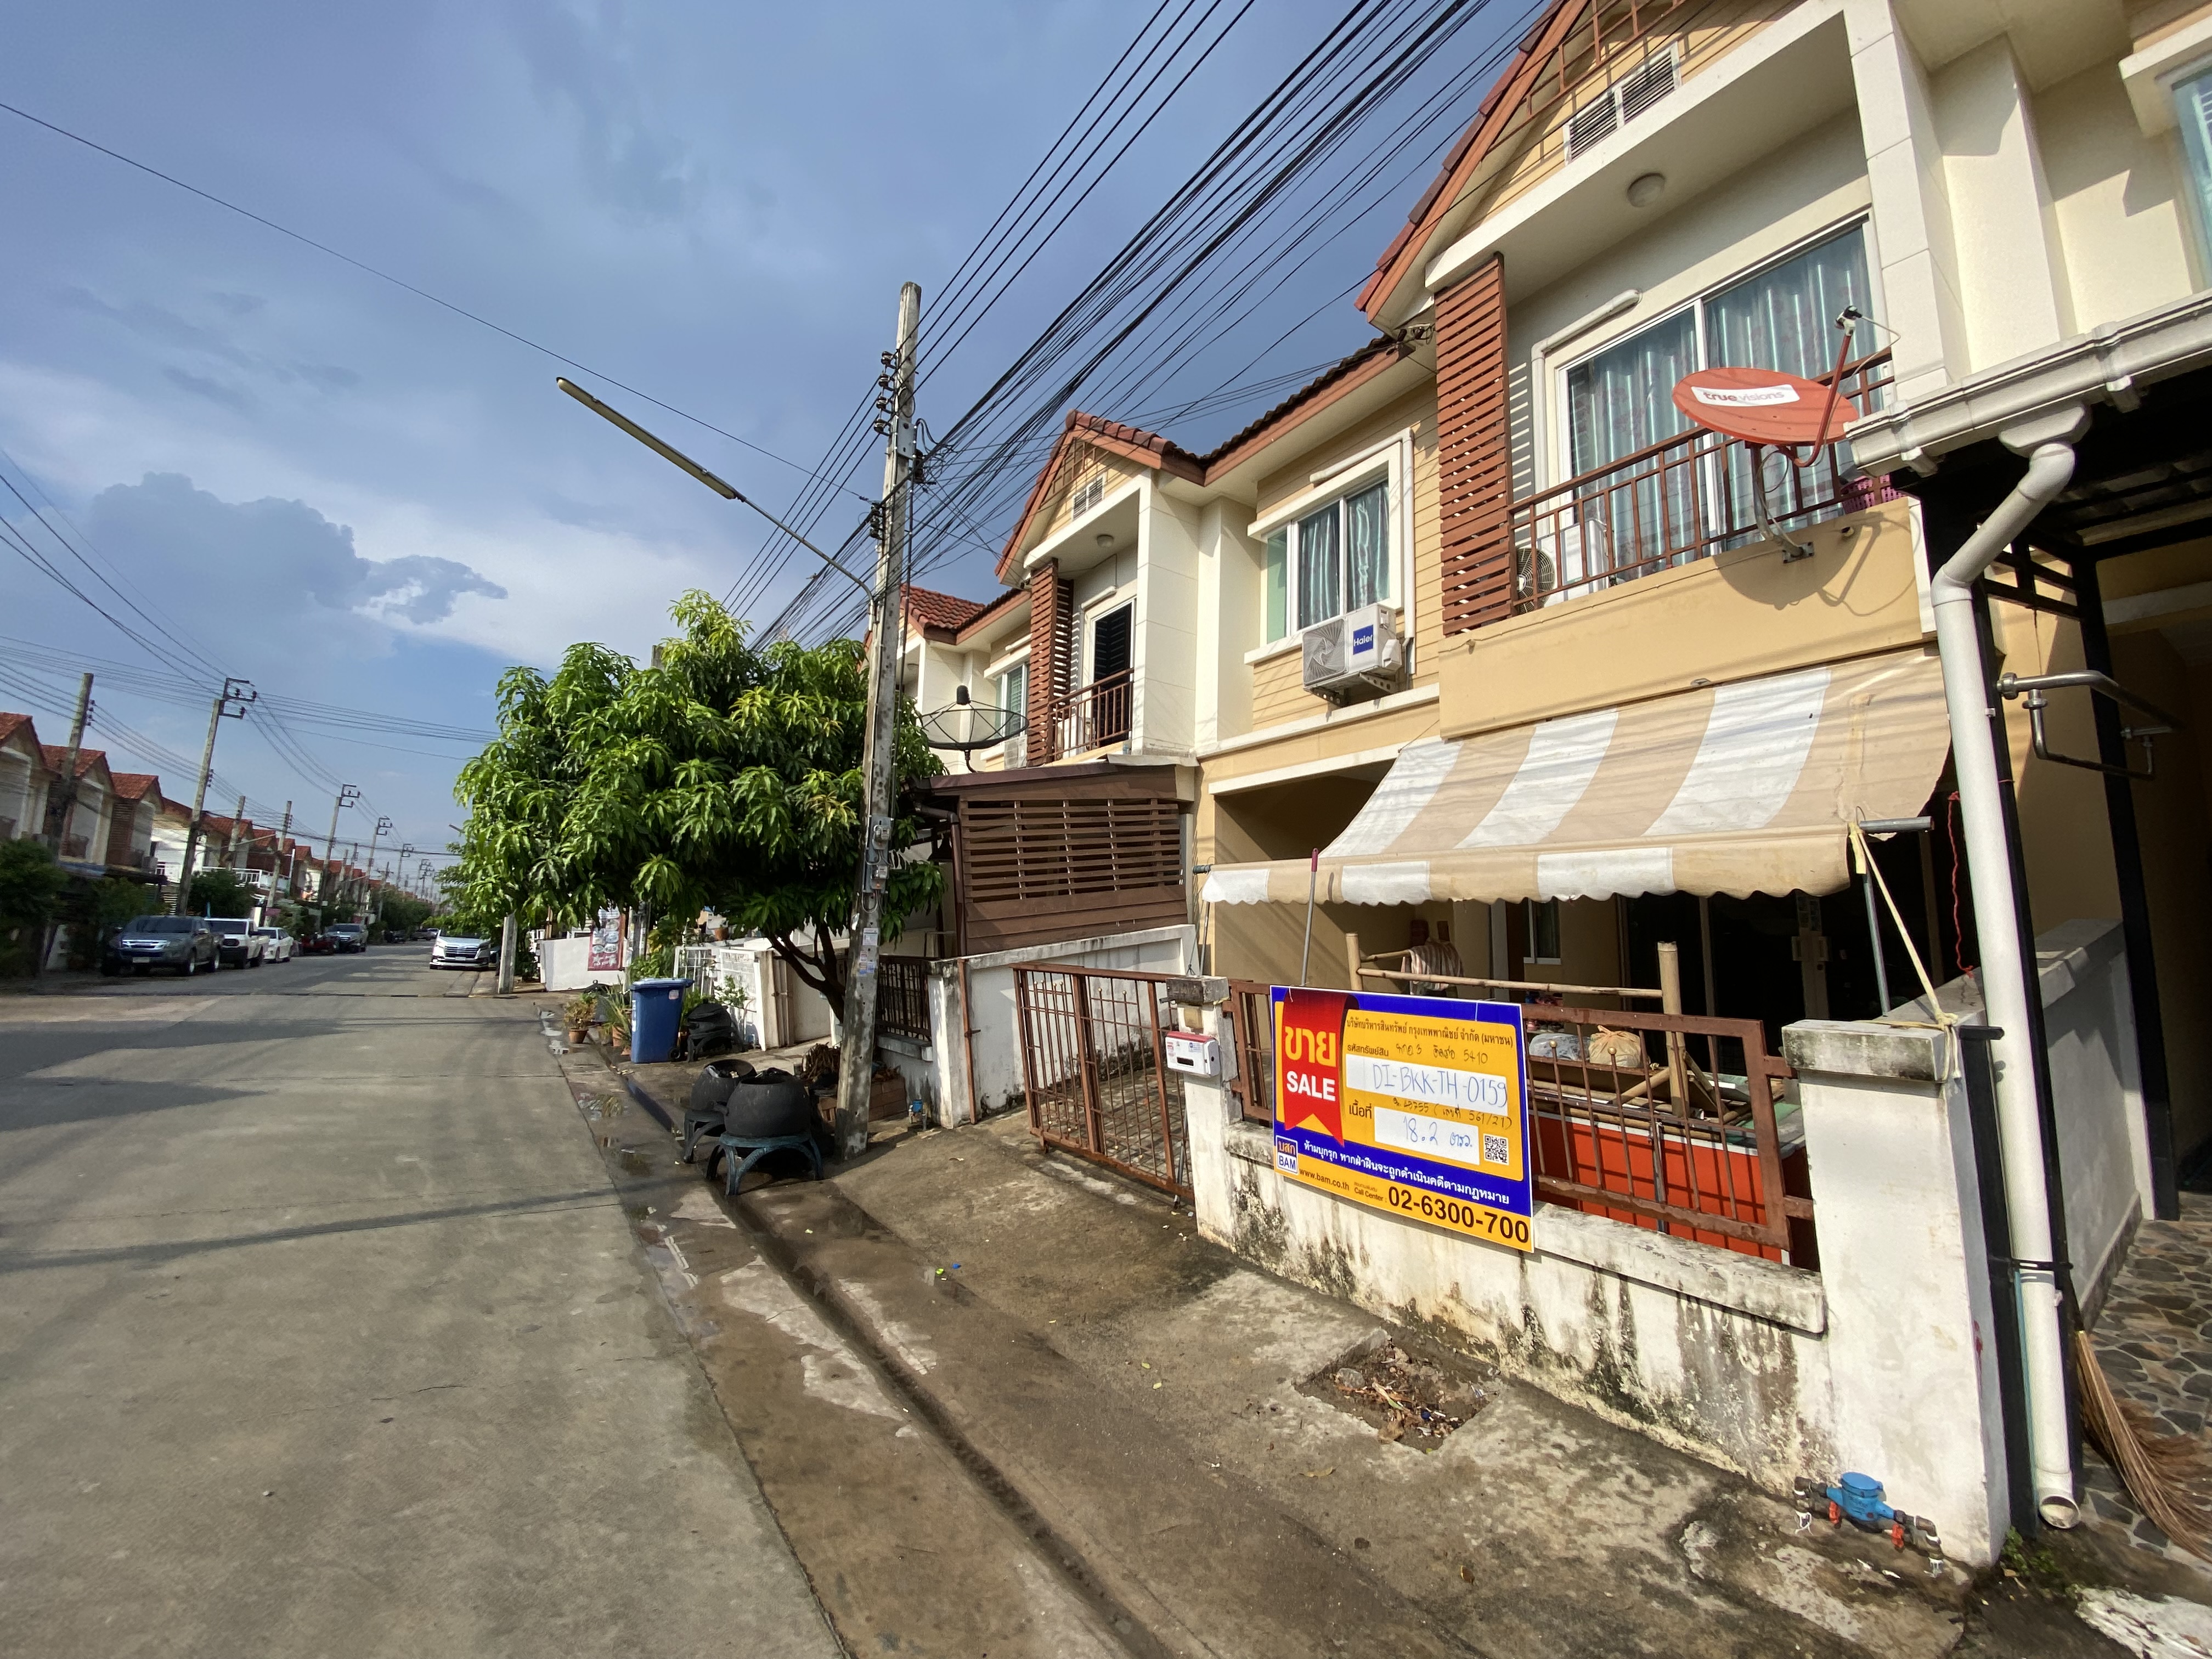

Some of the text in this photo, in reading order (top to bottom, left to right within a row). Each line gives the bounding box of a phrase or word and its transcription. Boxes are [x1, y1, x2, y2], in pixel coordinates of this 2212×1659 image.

[1353, 634, 1373, 647] Haier
[1284, 1025, 1336, 1068] ขาย
[1408, 1026, 1459, 1040] กรุงเทพพาณิชย์
[1460, 1028, 1480, 1042] จำกัด
[1481, 1033, 1513, 1048] (มหาชน)
[1347, 1043, 1389, 1057] รหัสทรัพย์สิน
[1286, 1070, 1336, 1102] SALE
[1348, 1099, 1372, 1120] เนื้อที่
[1403, 1115, 1438, 1146] 18.2
[1277, 1139, 1296, 1155] บสก
[1304, 1139, 1338, 1162] ห้ามบุกรุก
[1279, 1155, 1296, 1171] BAM
[1299, 1168, 1350, 1192] www.bam.co.th
[1354, 1187, 1364, 1195] Call
[1389, 1186, 1529, 1243] 02-6300-700
